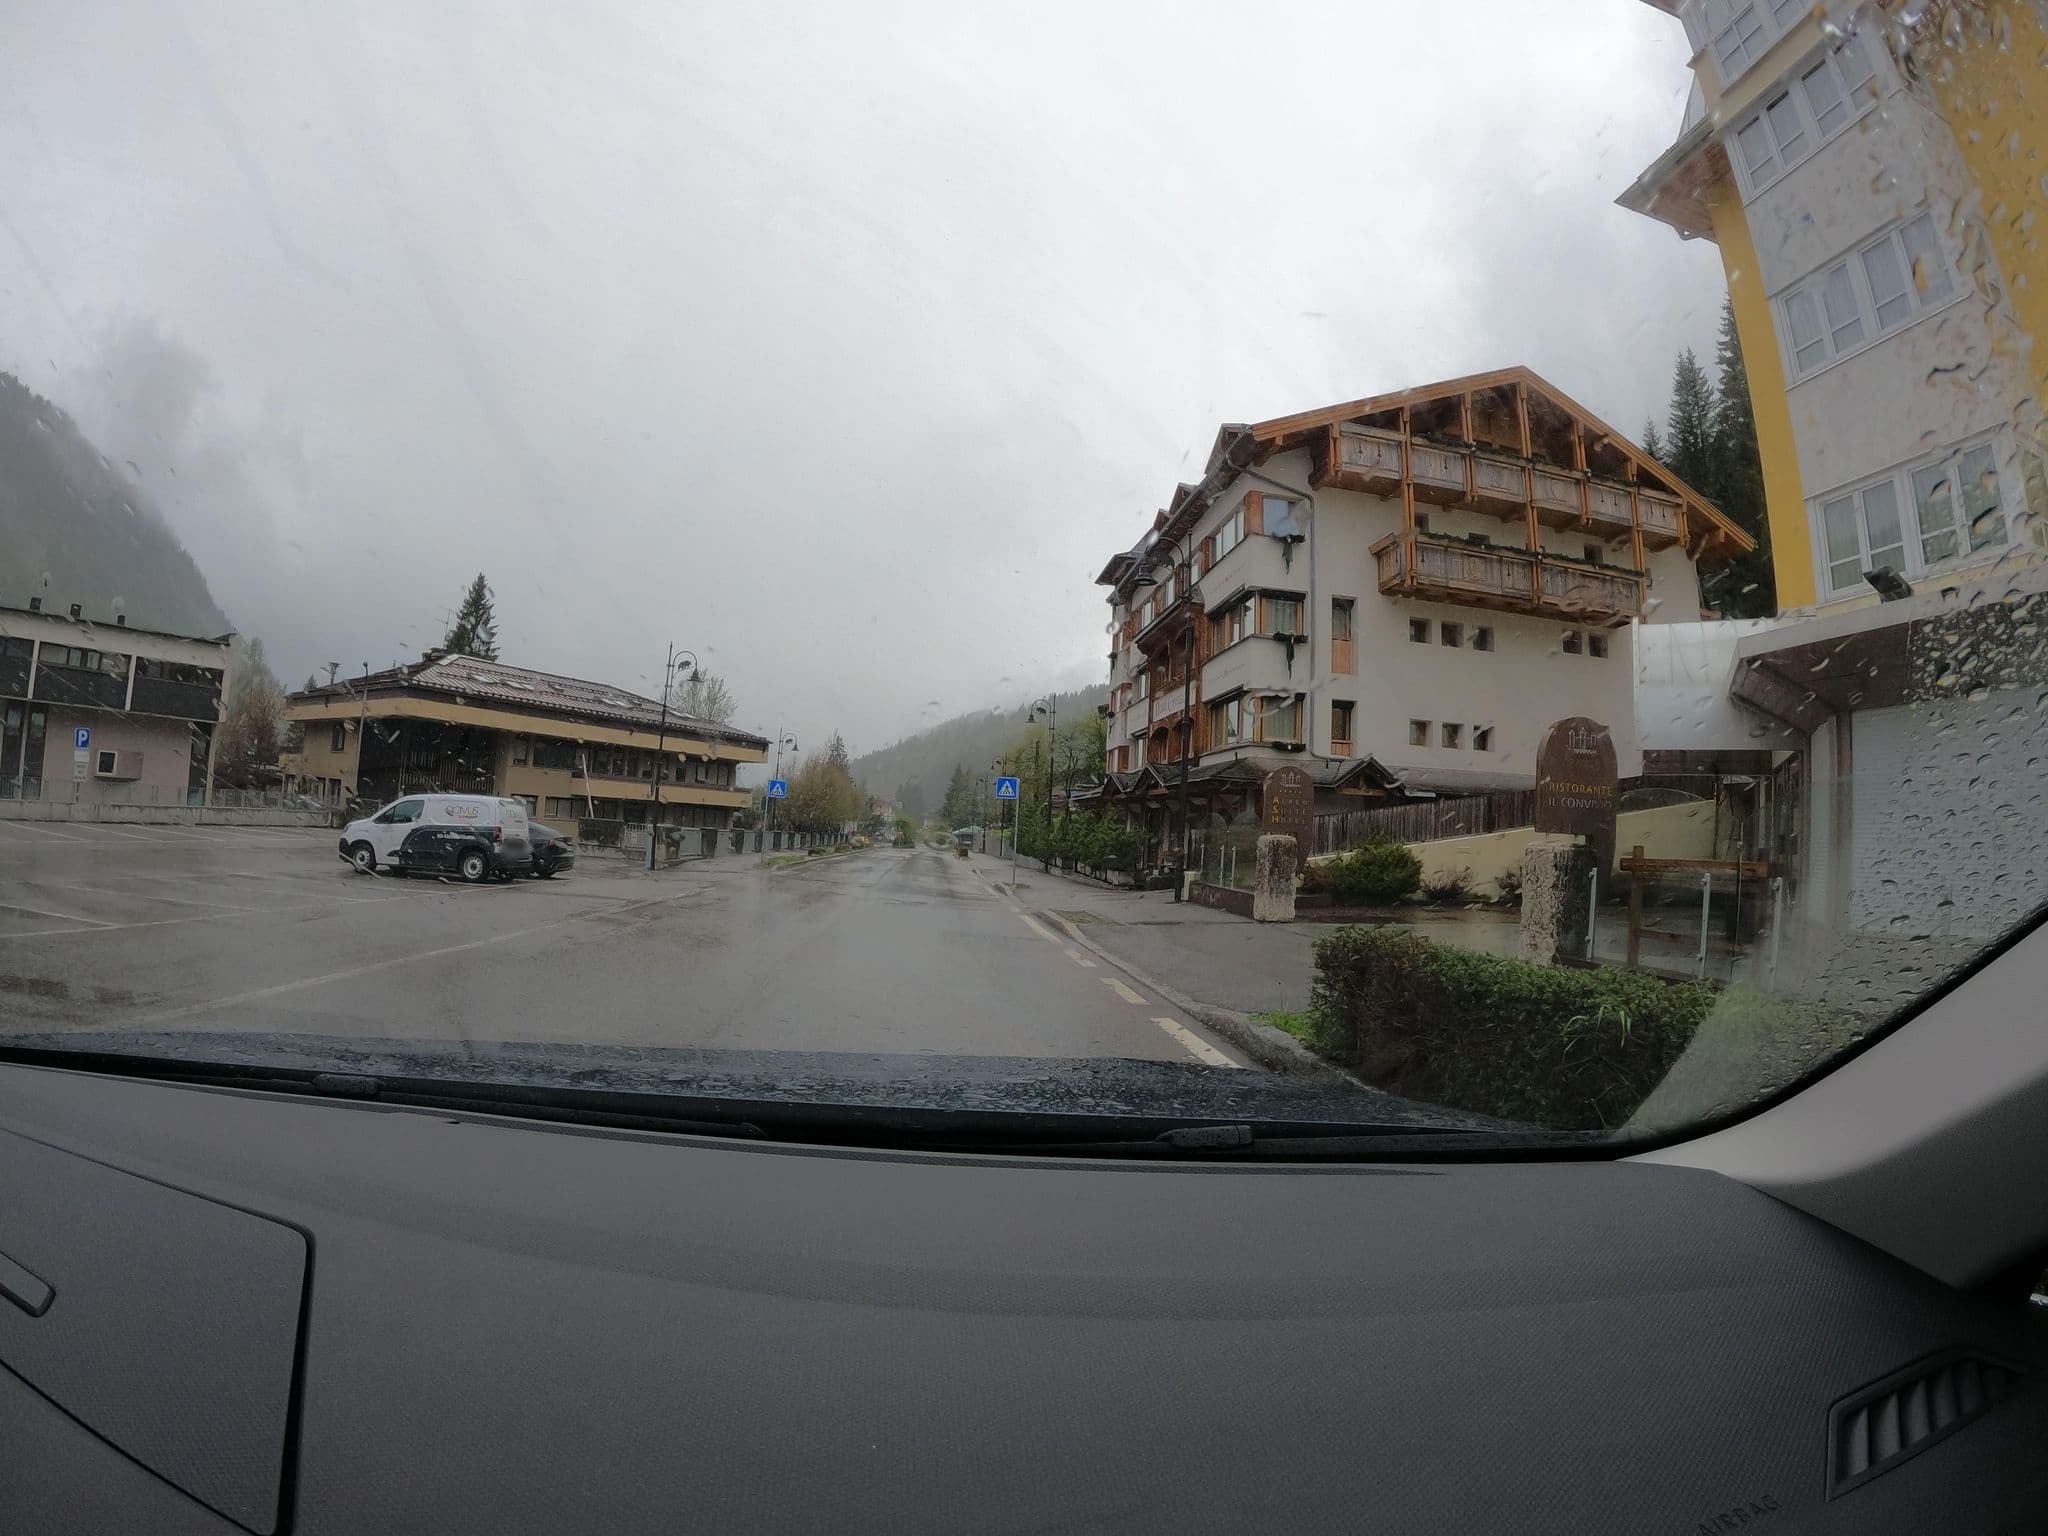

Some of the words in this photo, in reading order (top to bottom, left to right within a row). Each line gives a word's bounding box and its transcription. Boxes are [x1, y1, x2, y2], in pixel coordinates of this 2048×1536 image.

[78, 730, 88, 746] P
[1549, 782, 1613, 796] RISTORANTE
[1696, 1495, 1783, 1536] AIRBAG
